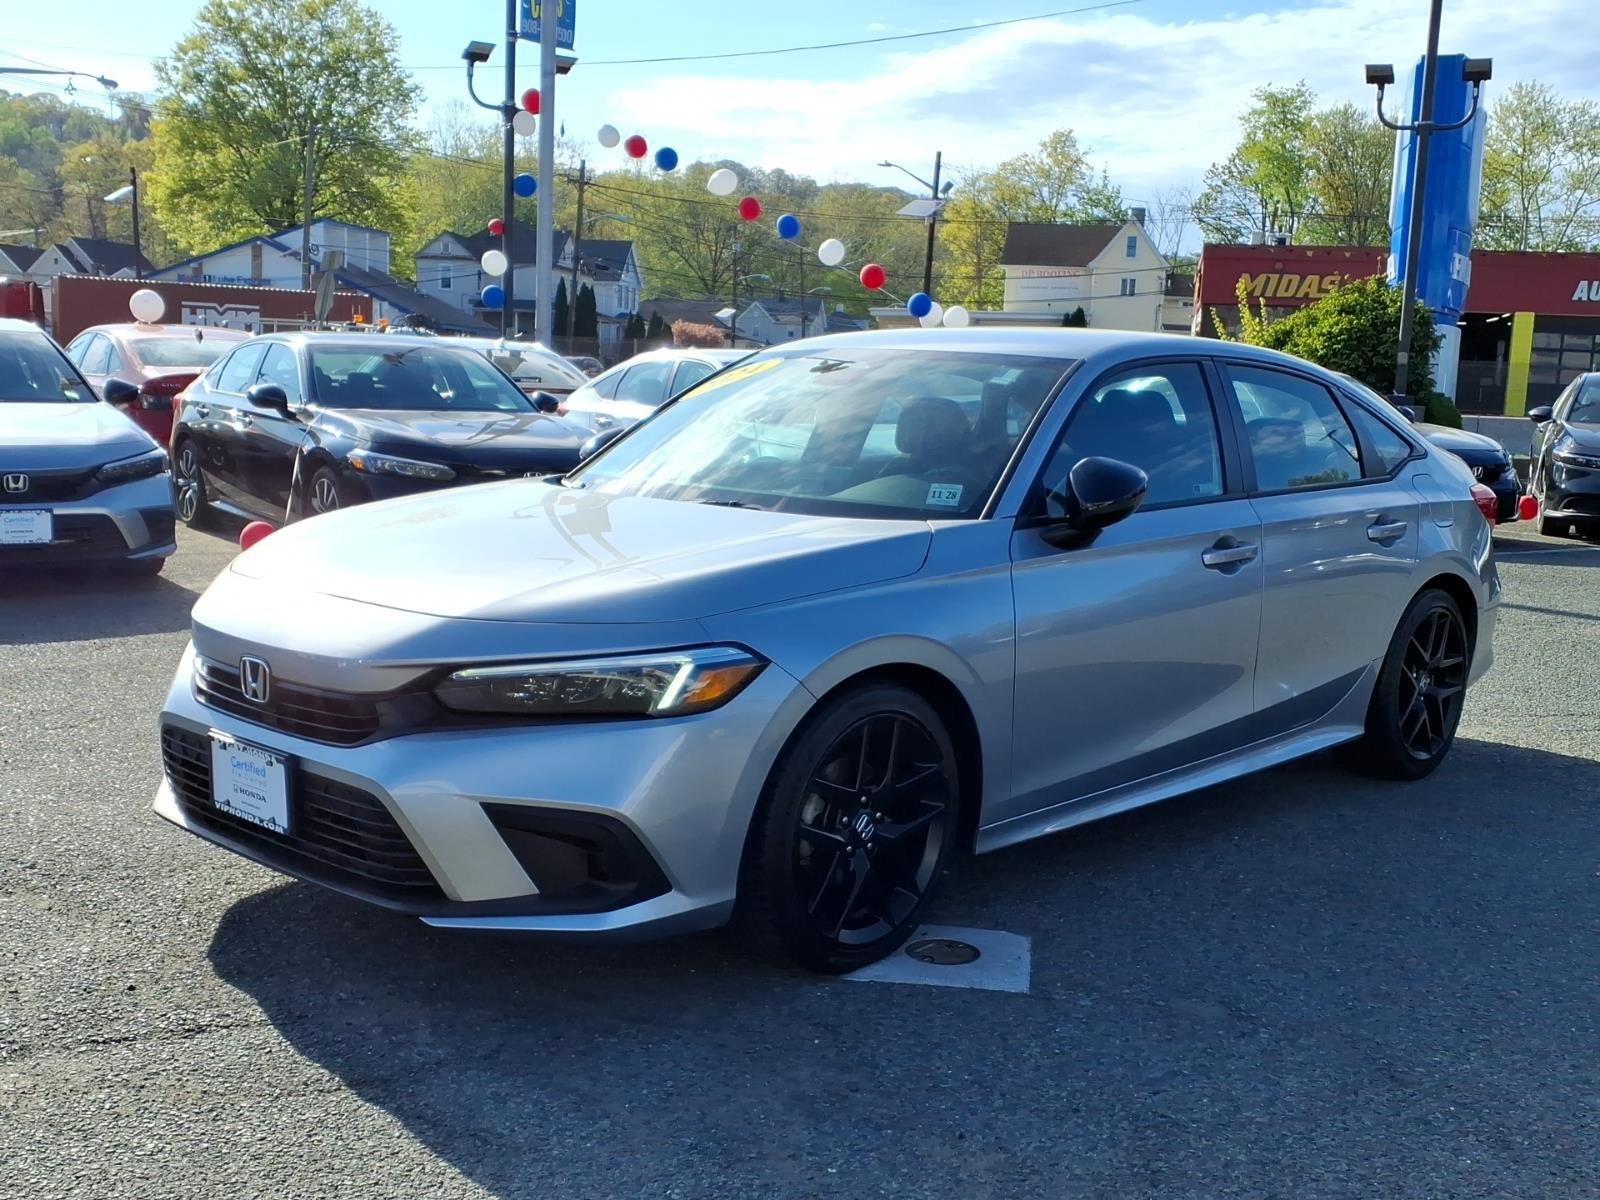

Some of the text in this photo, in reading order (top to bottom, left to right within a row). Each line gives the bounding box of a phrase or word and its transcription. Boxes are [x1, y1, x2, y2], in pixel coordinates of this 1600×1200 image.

[1237, 272, 1341, 298] MIDAS
[231, 756, 266, 778] Certified
[239, 787, 267, 803] HONDA
[214, 801, 284, 834] VIPHONDA.COM
